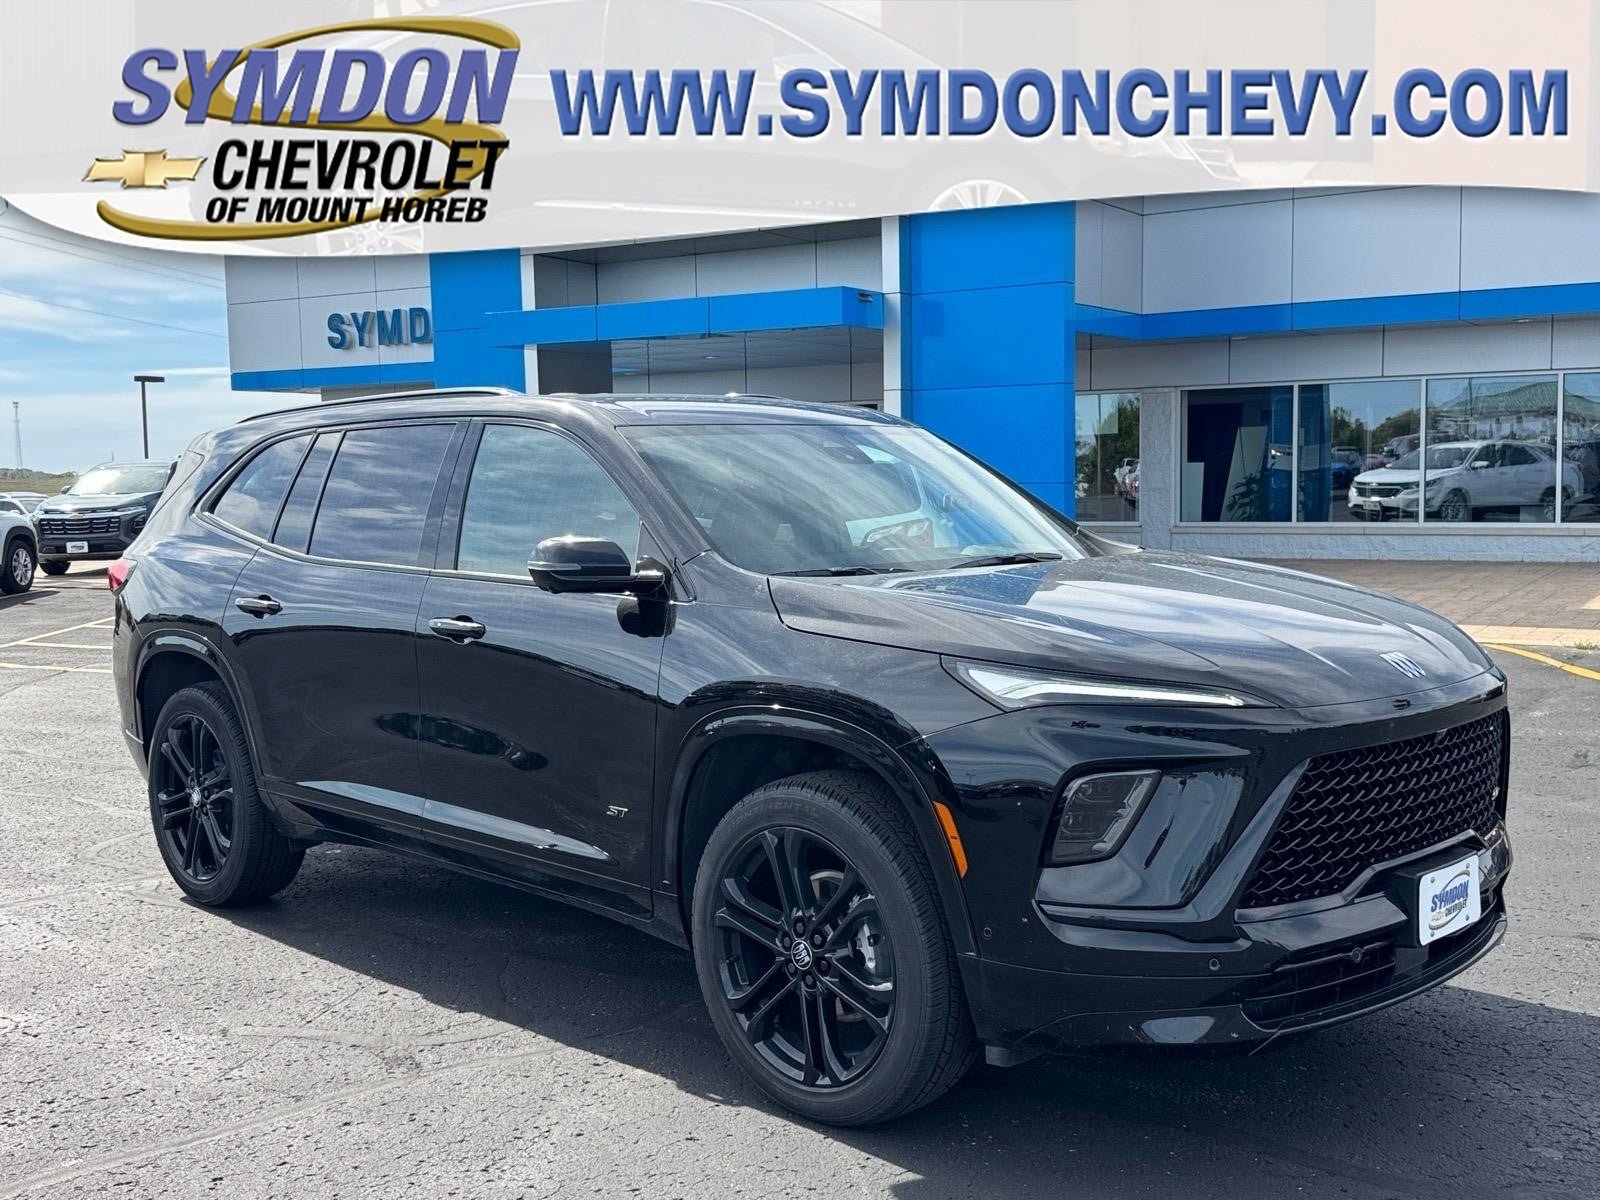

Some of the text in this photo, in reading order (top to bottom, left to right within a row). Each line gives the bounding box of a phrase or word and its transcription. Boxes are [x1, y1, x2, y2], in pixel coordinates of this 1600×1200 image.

[327, 307, 433, 350] SYMD
[606, 805, 628, 818] ST
[1431, 880, 1469, 912] SYMDON
